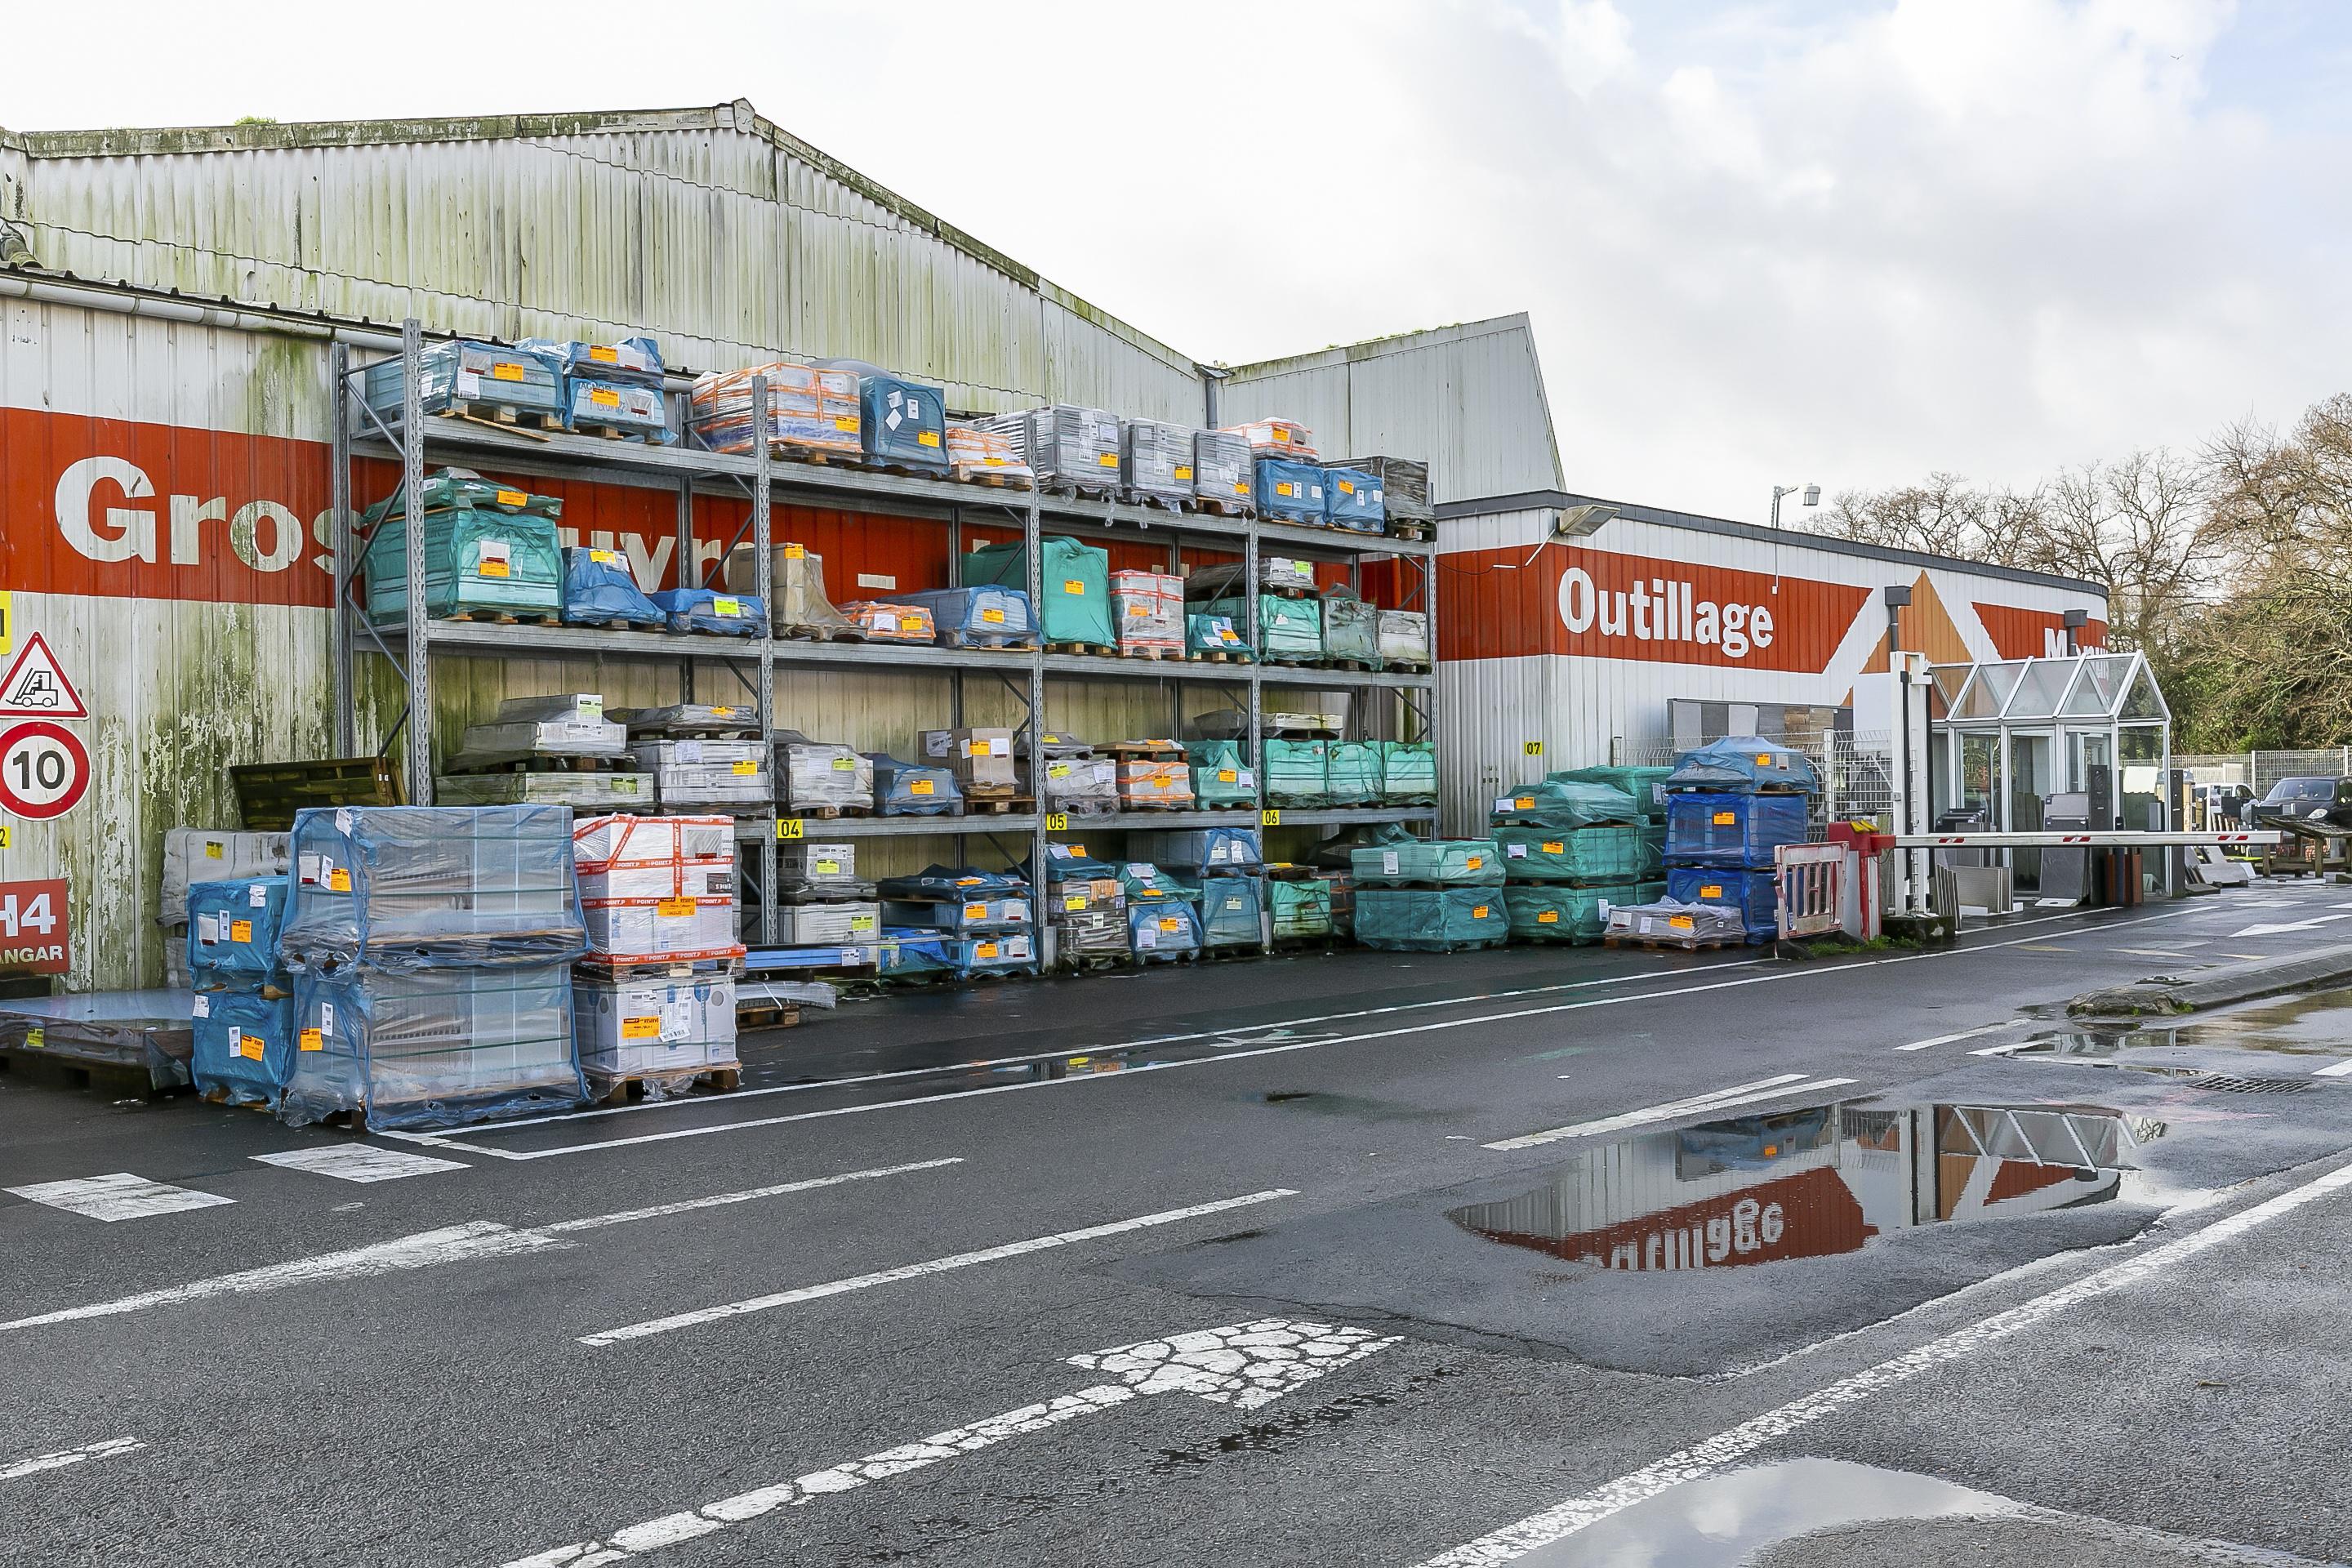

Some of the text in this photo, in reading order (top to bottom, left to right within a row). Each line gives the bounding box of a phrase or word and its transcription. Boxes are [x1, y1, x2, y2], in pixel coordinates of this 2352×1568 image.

[1558, 567, 1774, 658] Outillage
[1526, 742, 1541, 755] 07
[13, 750, 65, 790] 10
[1049, 814, 1064, 829] 05
[1264, 811, 1278, 825] 06
[781, 822, 800, 837] 04
[0, 945, 63, 964] NGAR
